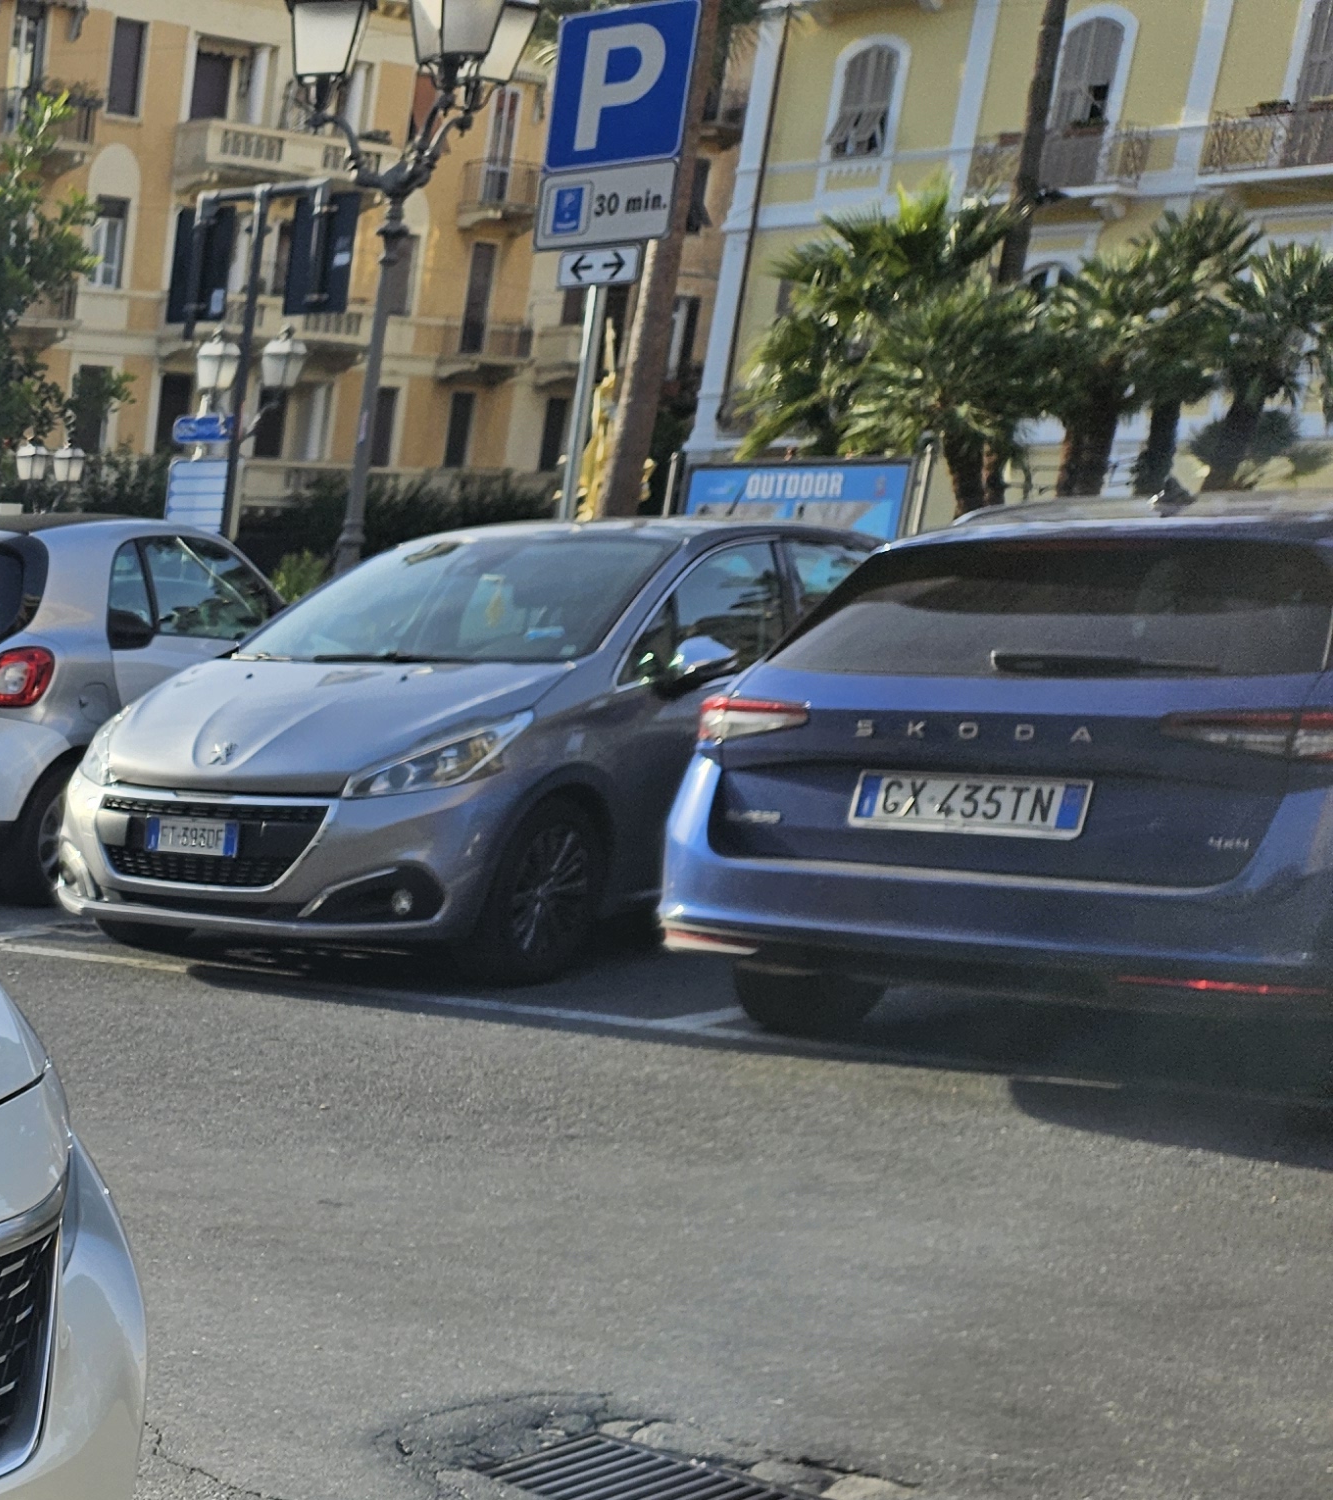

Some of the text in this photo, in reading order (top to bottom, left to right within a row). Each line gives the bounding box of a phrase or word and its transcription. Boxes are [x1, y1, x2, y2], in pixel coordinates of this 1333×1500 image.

[573, 22, 667, 152] P
[593, 189, 668, 217] 30 min.
[745, 471, 844, 499] OUTDOOR
[855, 719, 1092, 743] SKODA
[883, 780, 1056, 823] GX 435TN
